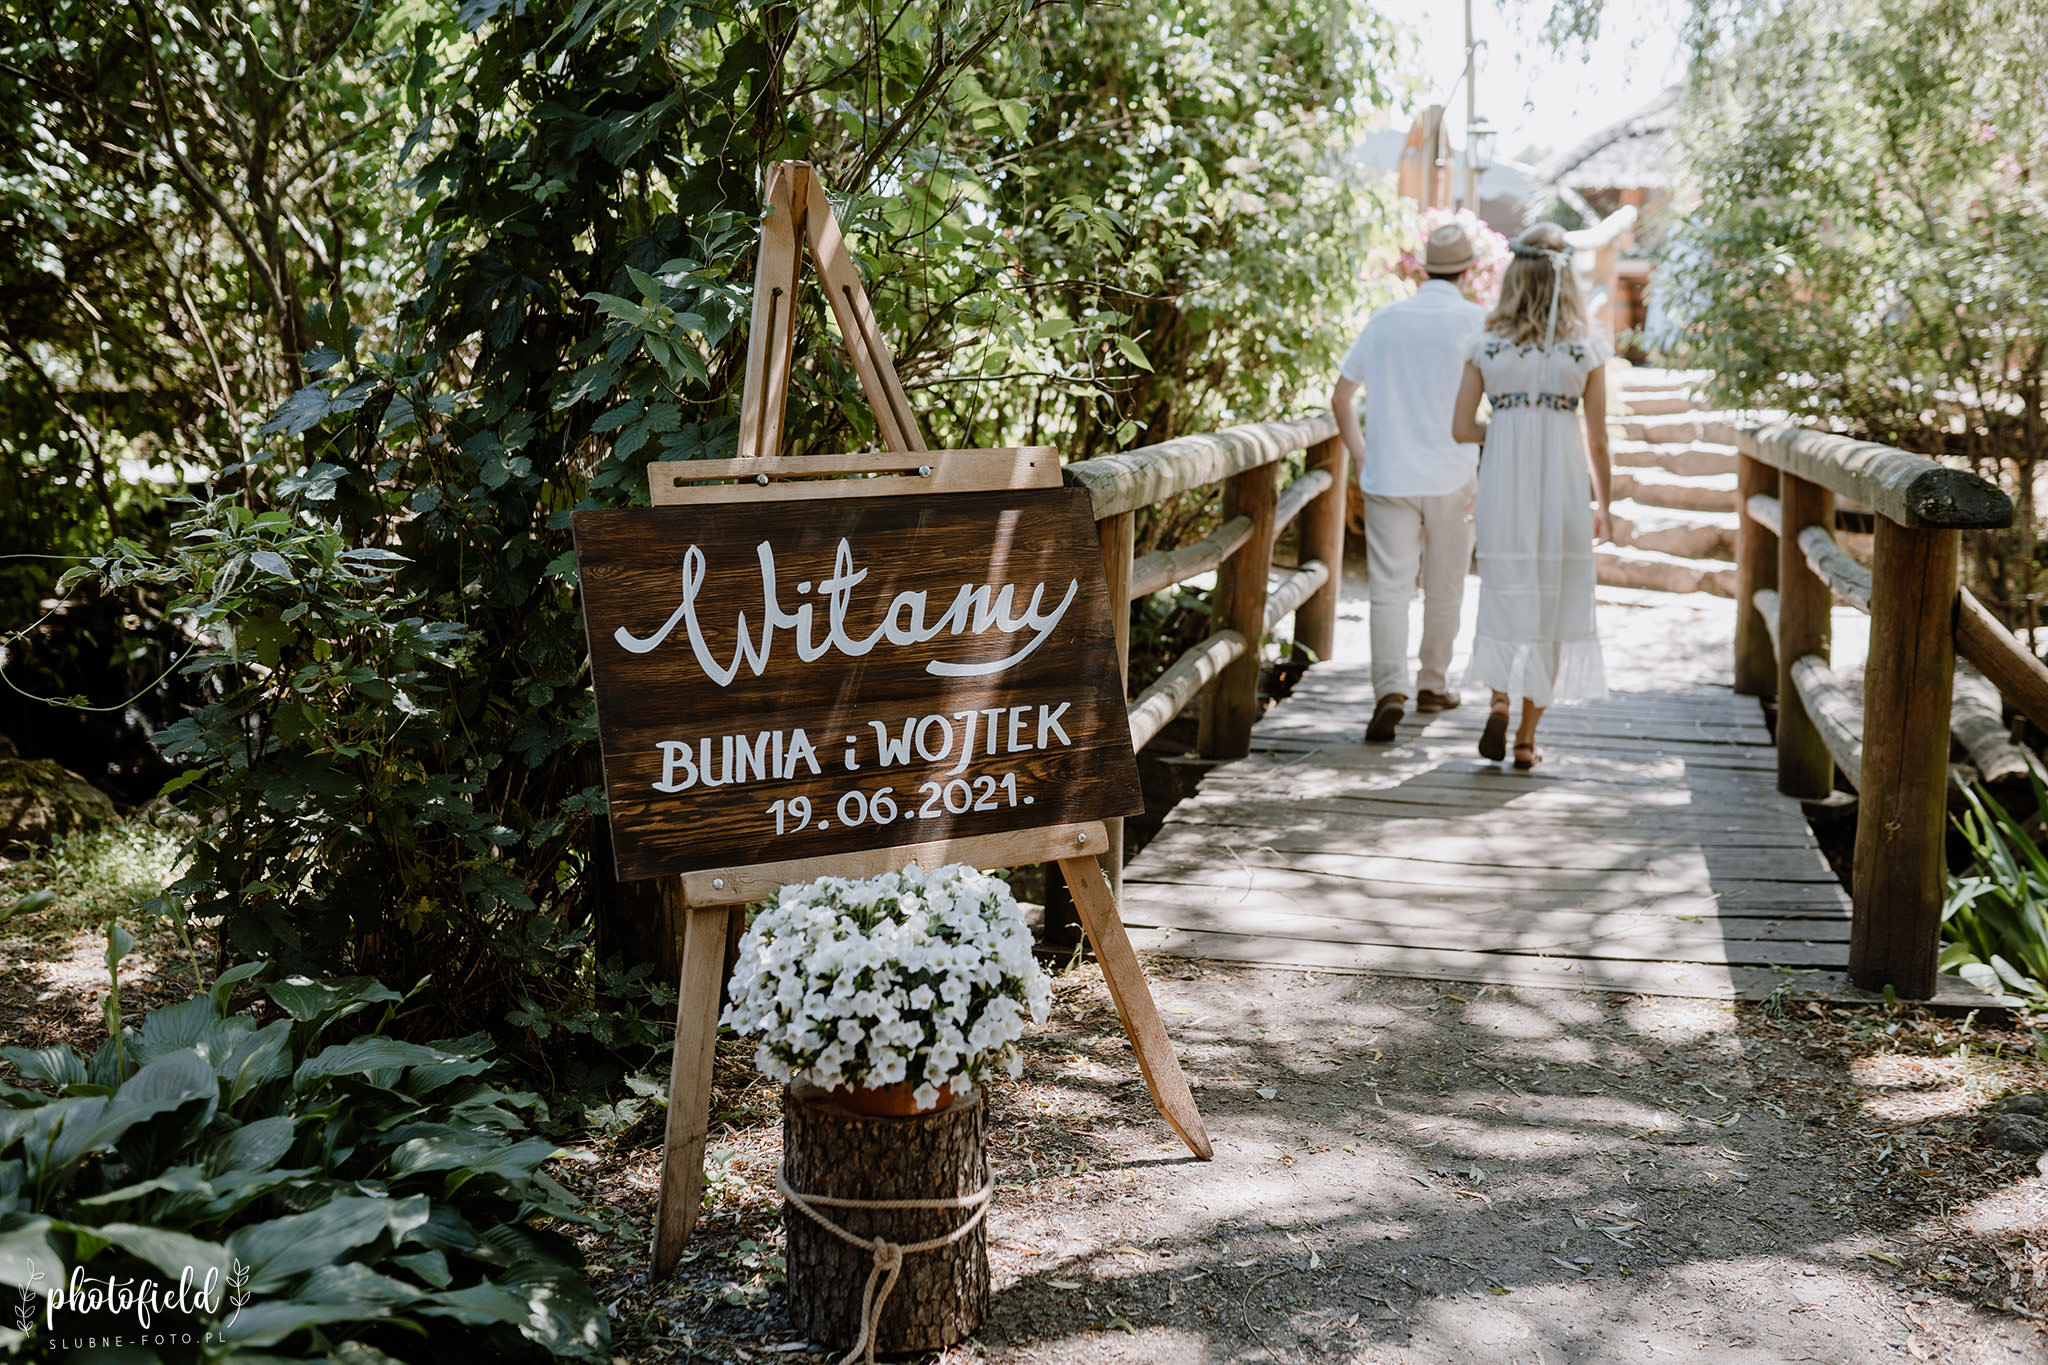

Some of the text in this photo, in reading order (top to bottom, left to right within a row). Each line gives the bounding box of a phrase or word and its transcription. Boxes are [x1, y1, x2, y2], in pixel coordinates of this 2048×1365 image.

[614, 537, 1079, 687] Witamy
[651, 702, 1072, 793] BUNIA i WOJTEK
